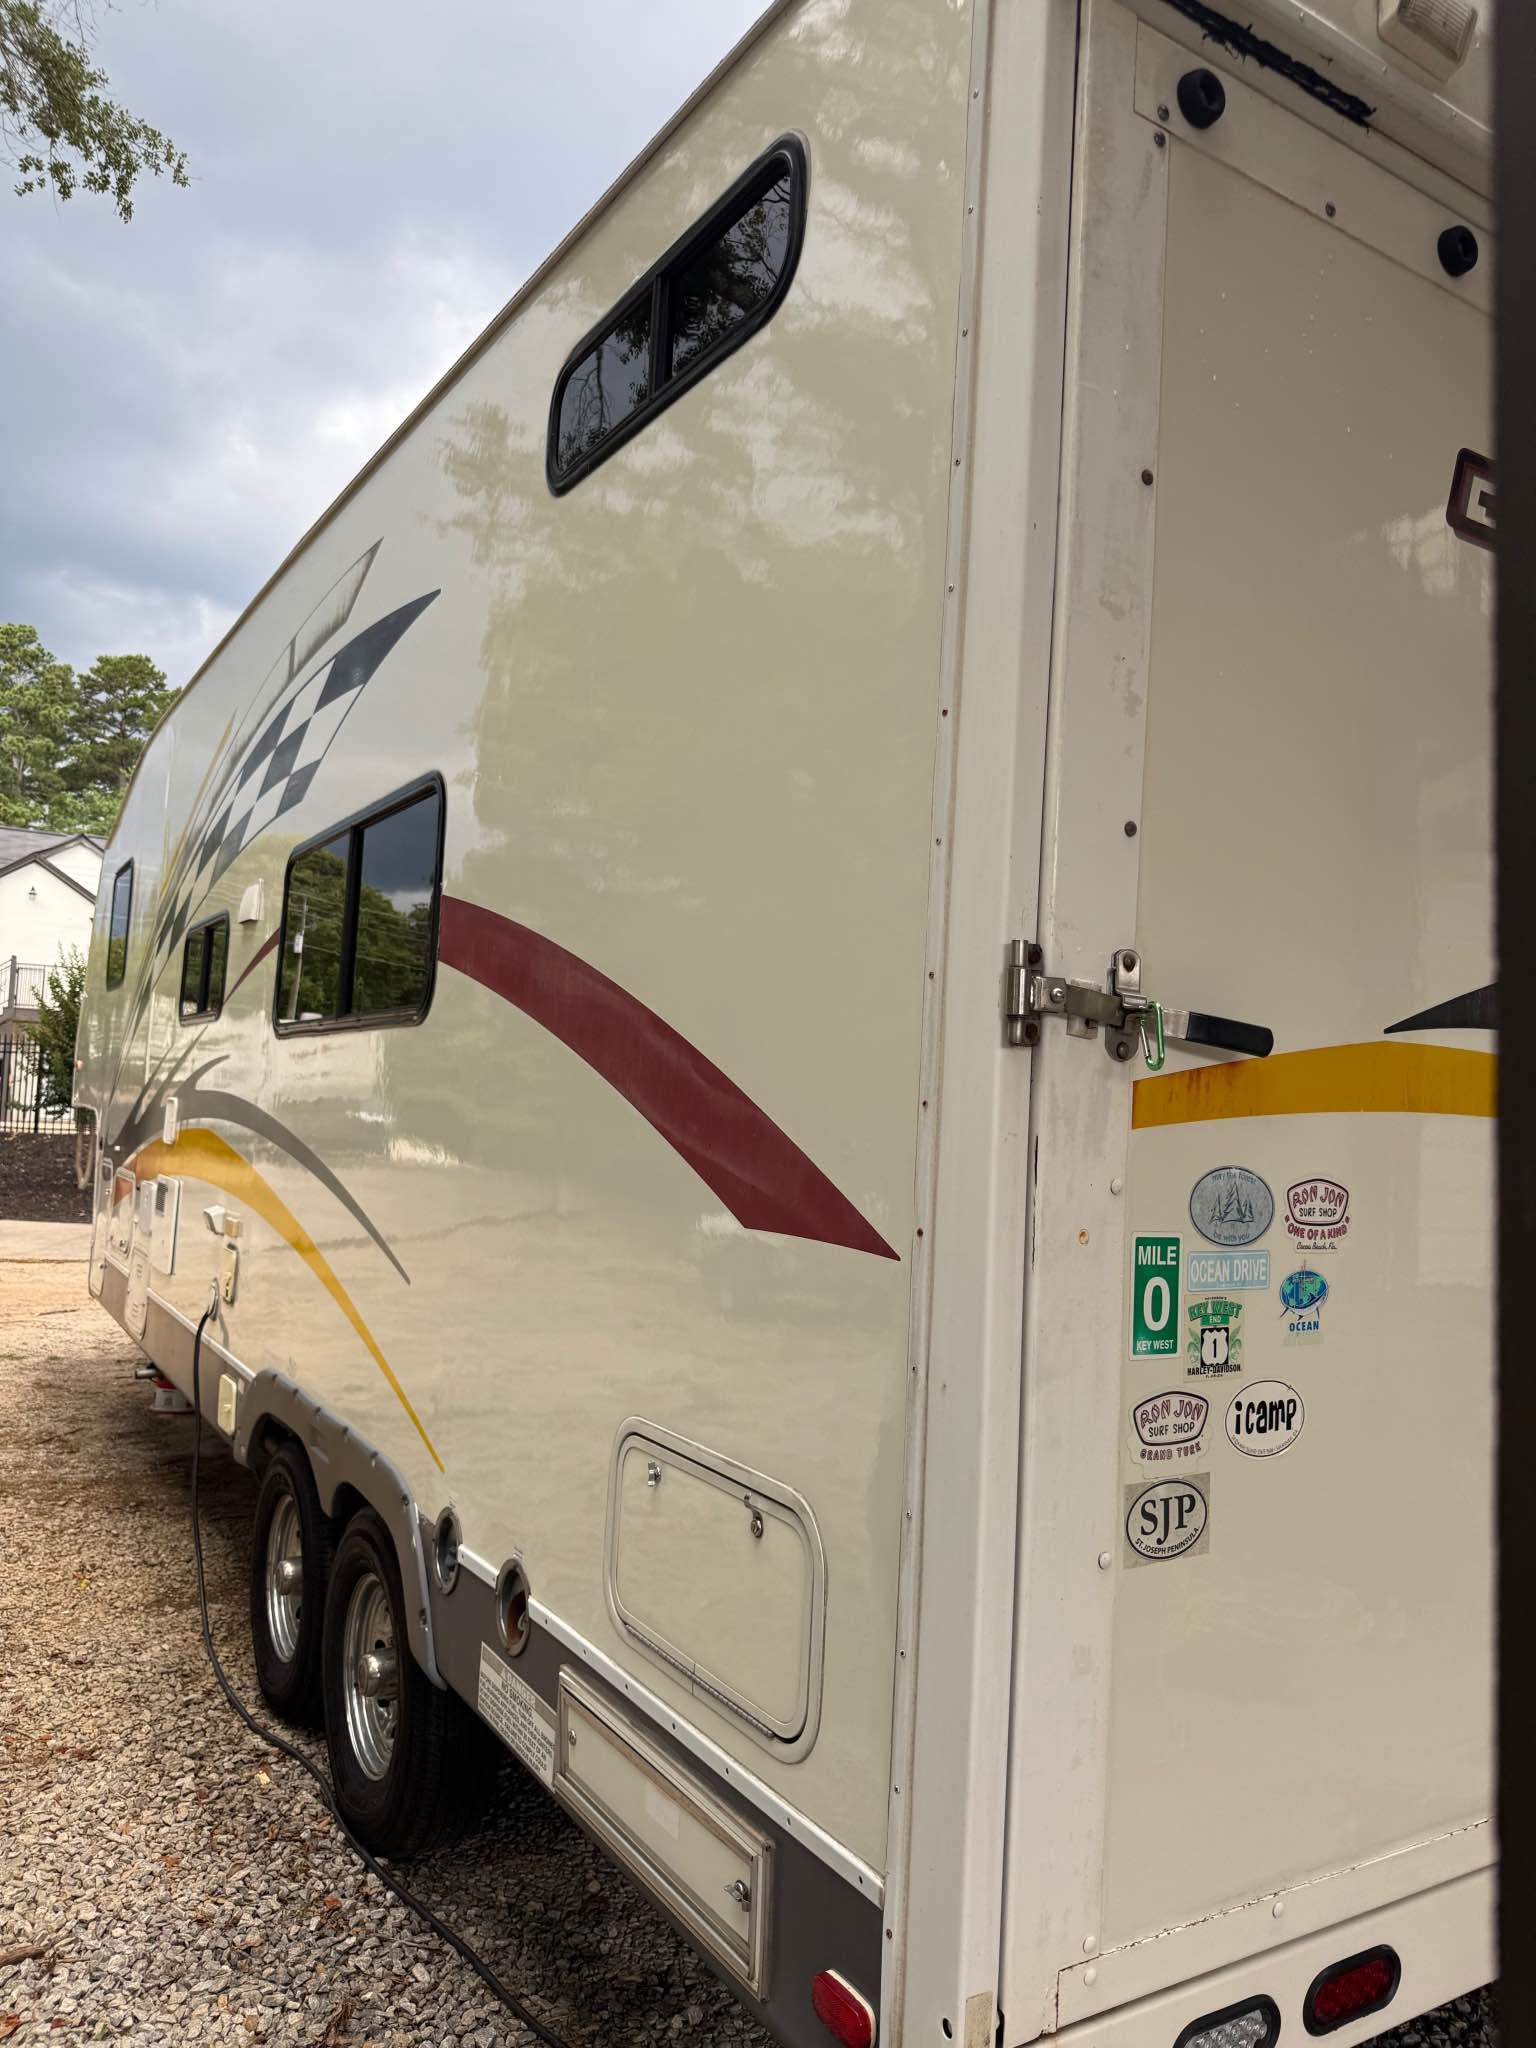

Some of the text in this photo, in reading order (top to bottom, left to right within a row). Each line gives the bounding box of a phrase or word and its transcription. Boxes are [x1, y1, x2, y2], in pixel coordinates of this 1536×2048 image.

[1292, 1185, 1345, 1208] RON JON
[1299, 1207, 1337, 1217] SURF SHOP
[1287, 1222, 1347, 1240] ONE OF A KIND
[1138, 1246, 1177, 1265] MILE
[1190, 1259, 1266, 1283] OCEAN DRIVE
[1143, 1276, 1170, 1331] 0
[1188, 1300, 1243, 1321] KEY WEST
[1209, 1316, 1222, 1324] END
[1289, 1321, 1319, 1332] OCEAN
[1136, 1339, 1174, 1351] KEY WEST
[1212, 1336, 1217, 1358] 1
[1187, 1364, 1241, 1376] HARLEY-DAVIDSON
[1140, 1400, 1204, 1429] RON JON
[1235, 1399, 1297, 1434] i camp
[1148, 1421, 1195, 1437] SURF SHOP
[1140, 1441, 1202, 1461] GRAND TURK
[1140, 1493, 1196, 1545] SJP
[1135, 1527, 1199, 1555] ST. JOSEPH PENINSULA
[502, 1680, 508, 1695] NO
